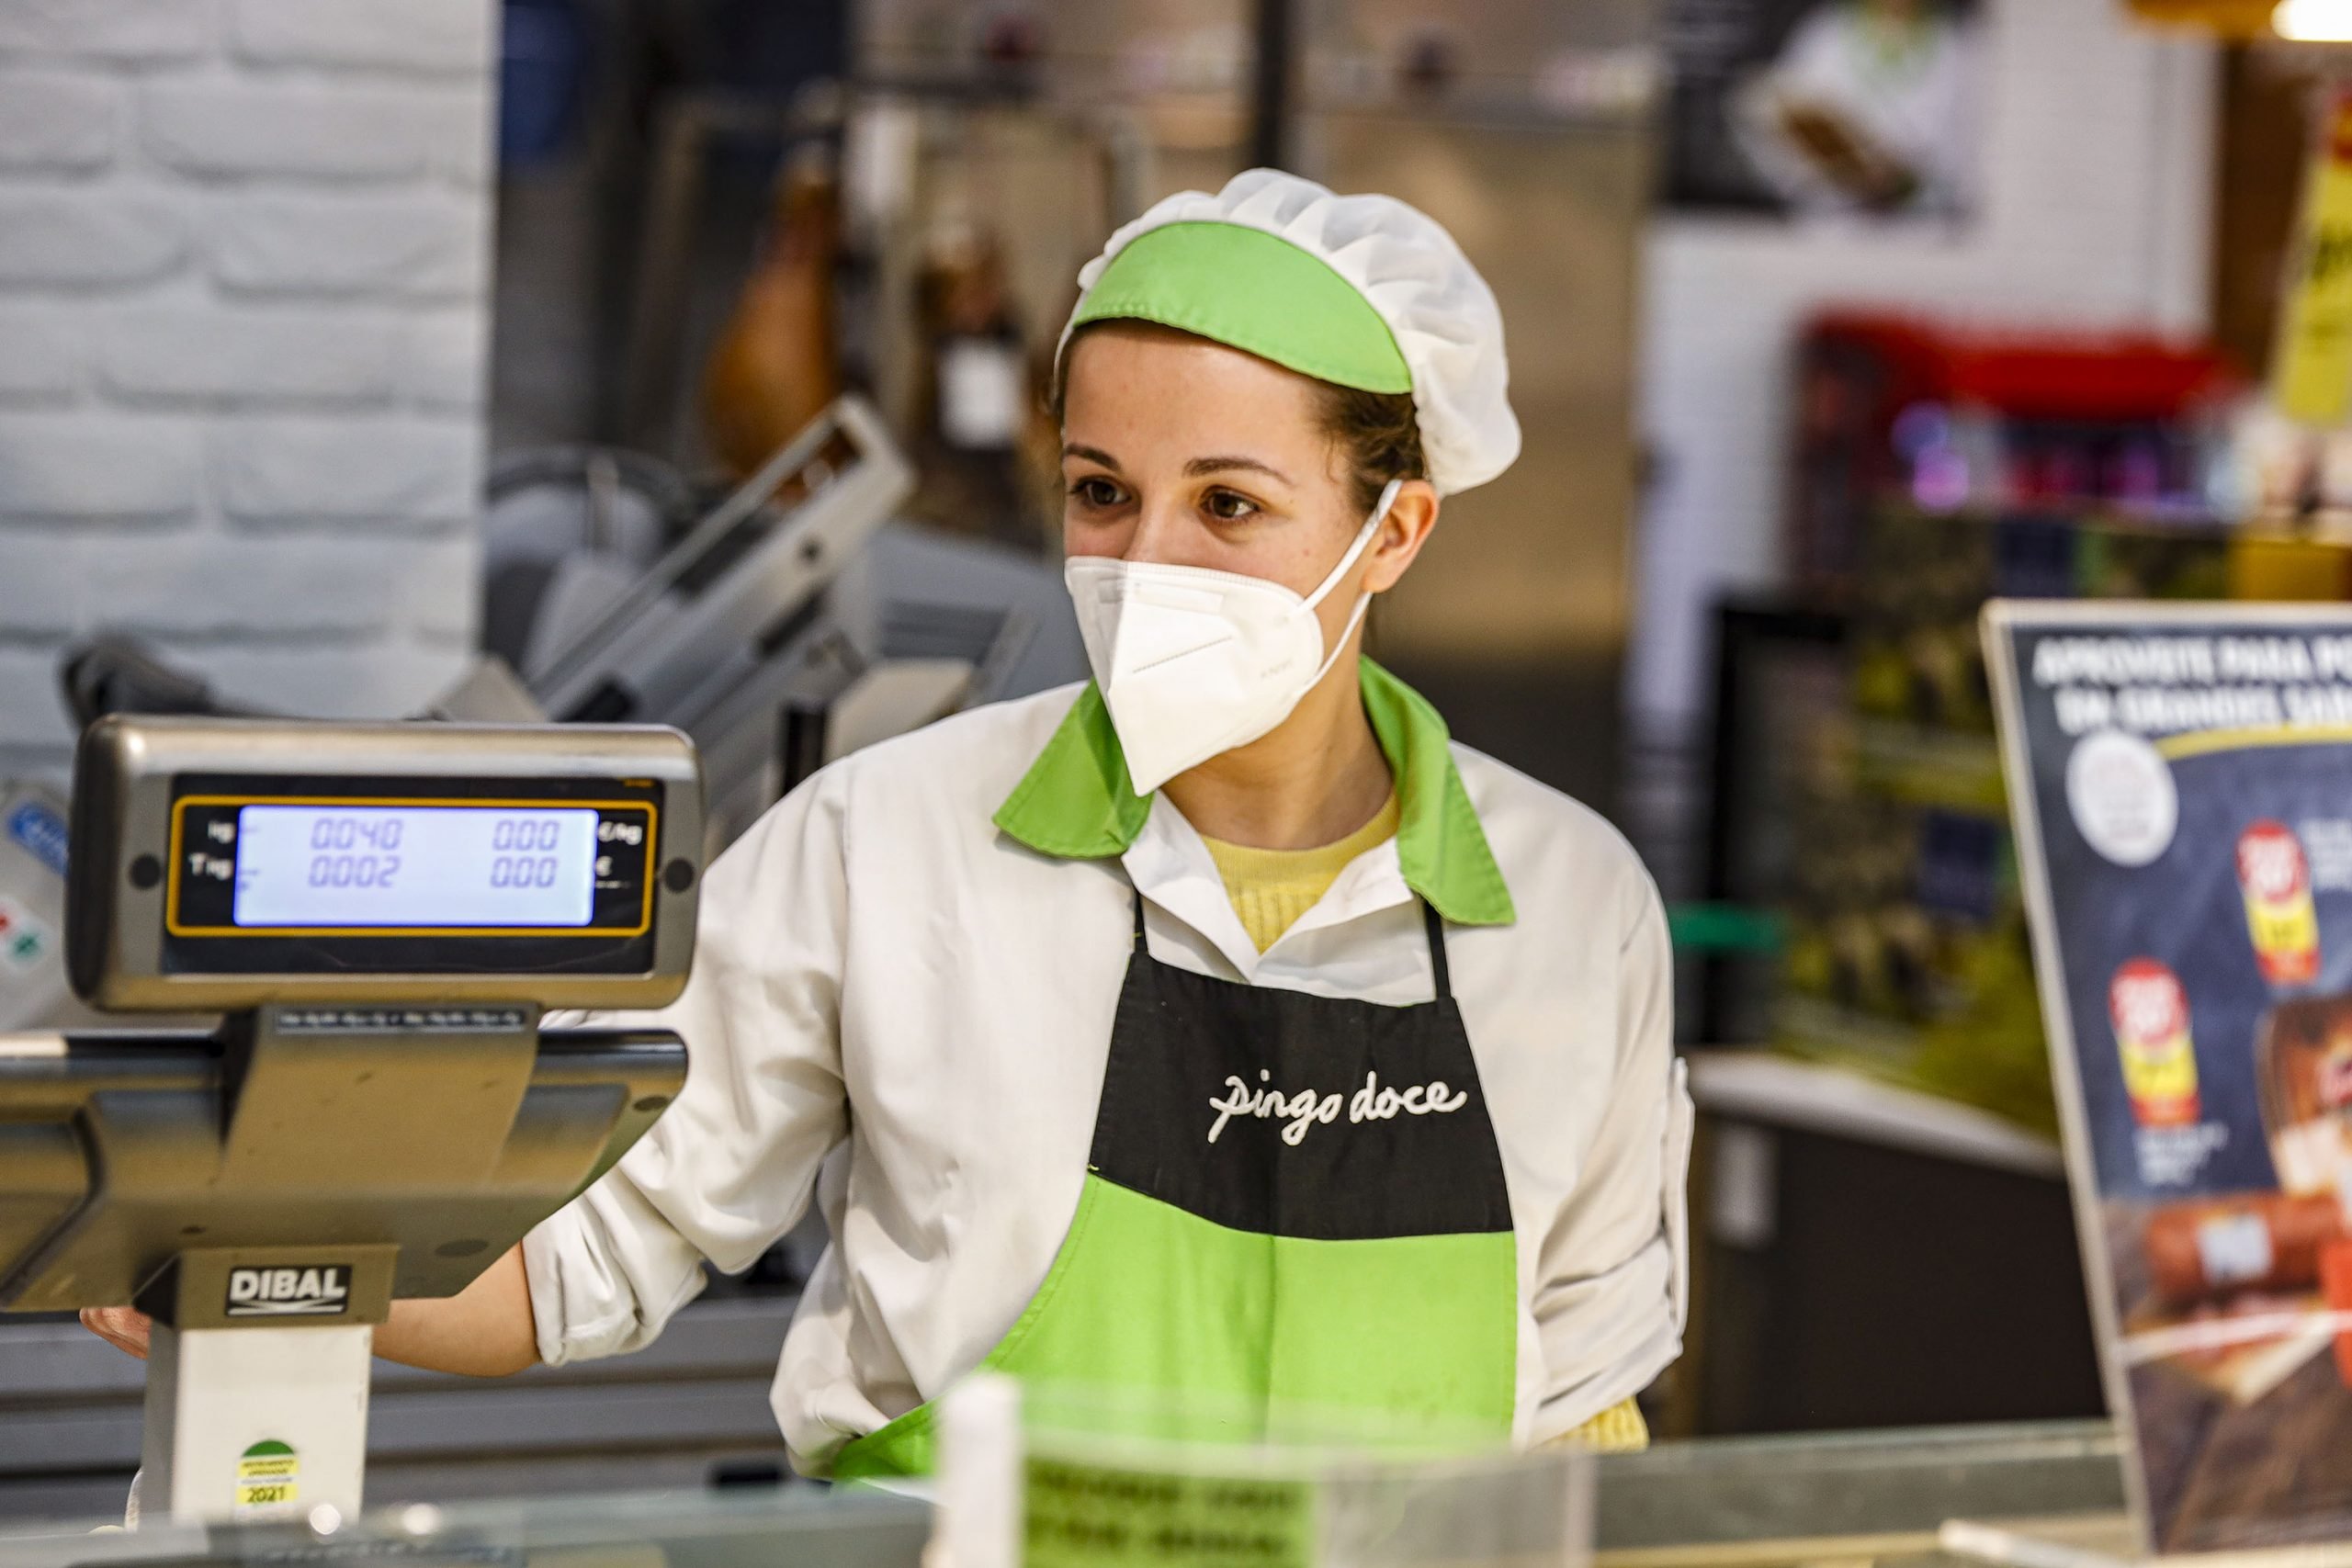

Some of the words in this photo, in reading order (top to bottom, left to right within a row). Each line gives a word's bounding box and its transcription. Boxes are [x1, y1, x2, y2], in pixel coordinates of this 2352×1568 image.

[1207, 1068, 1343, 1145] pingo
[1349, 1070, 1468, 1123] doce
[229, 1268, 347, 1301] DIBAL
[247, 1486, 286, 1503] 2021
